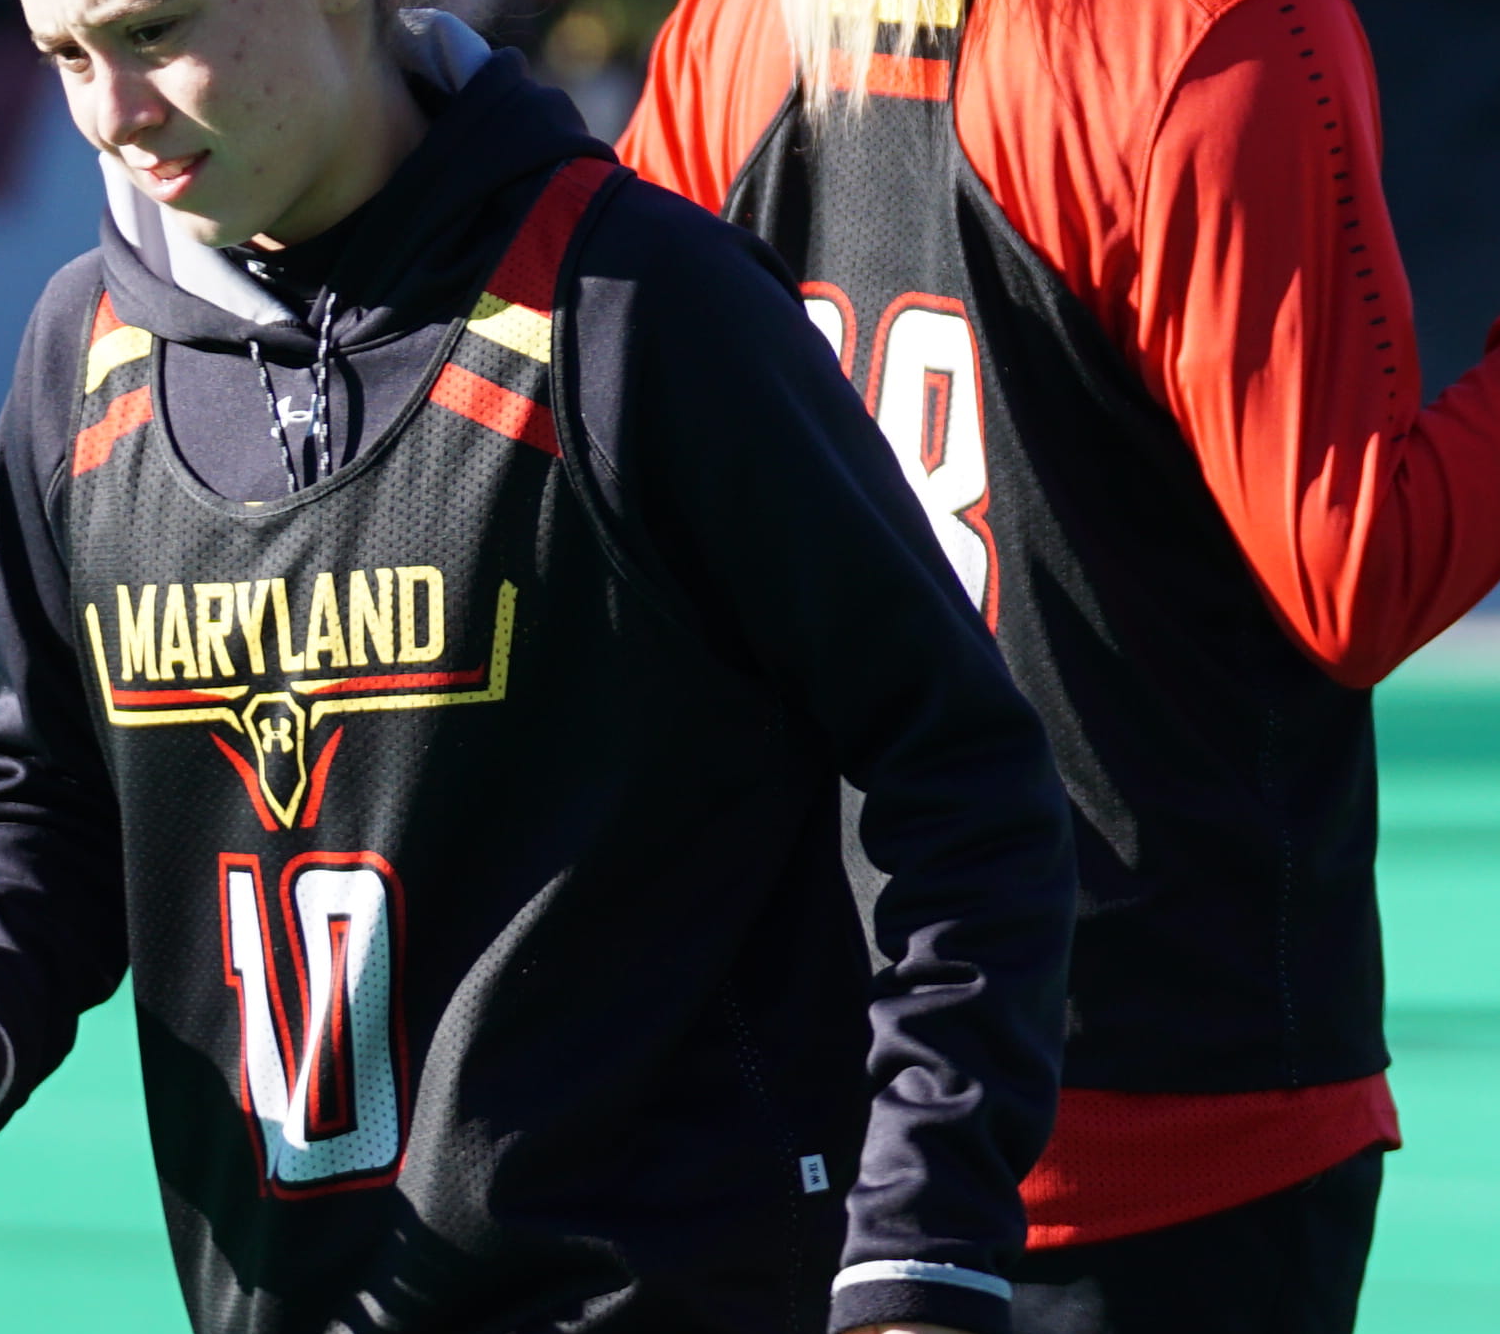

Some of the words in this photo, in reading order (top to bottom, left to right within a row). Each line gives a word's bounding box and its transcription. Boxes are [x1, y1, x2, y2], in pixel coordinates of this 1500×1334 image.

[116, 564, 447, 682] MARYLAND
[800, 280, 1000, 637] 8
[217, 850, 407, 1201] 10
